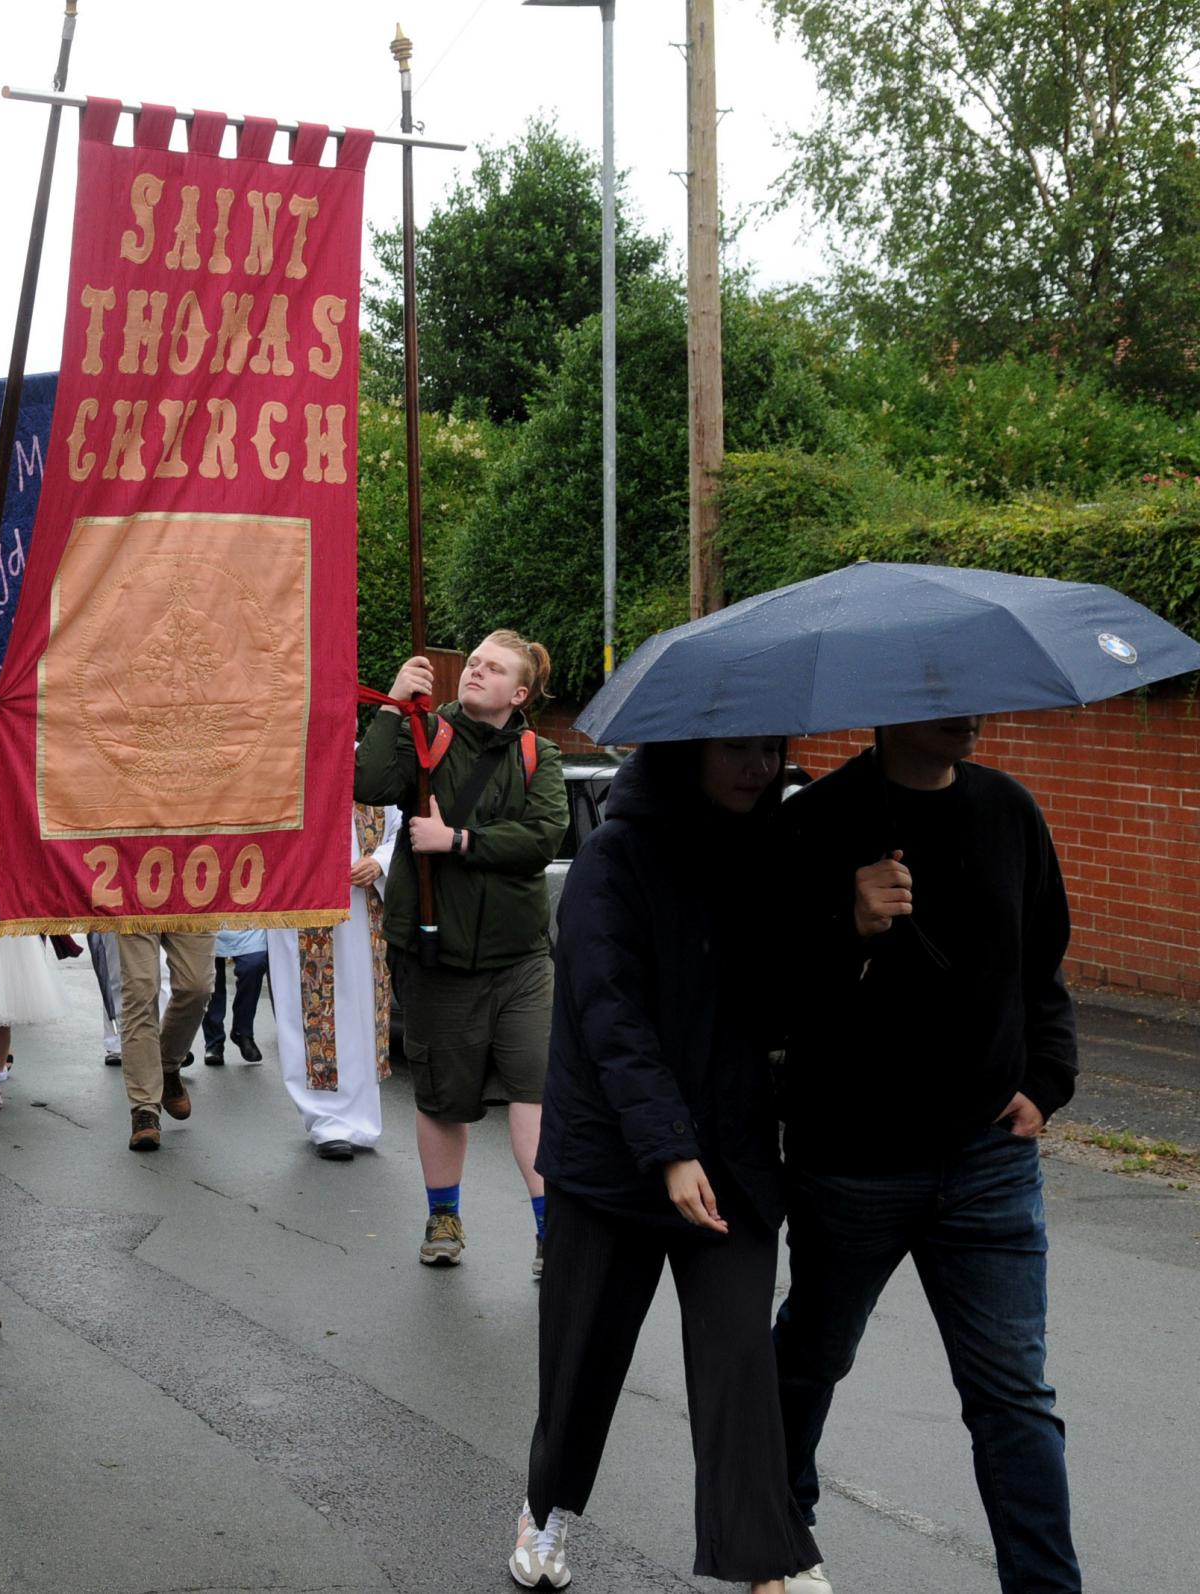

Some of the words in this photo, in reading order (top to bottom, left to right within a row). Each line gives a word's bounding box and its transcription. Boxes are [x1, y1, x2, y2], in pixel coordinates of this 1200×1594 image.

[120, 172, 319, 279] SAINT
[81, 283, 347, 380] THOMAS
[66, 397, 348, 484] CHURCH
[82, 843, 266, 909] 2000
